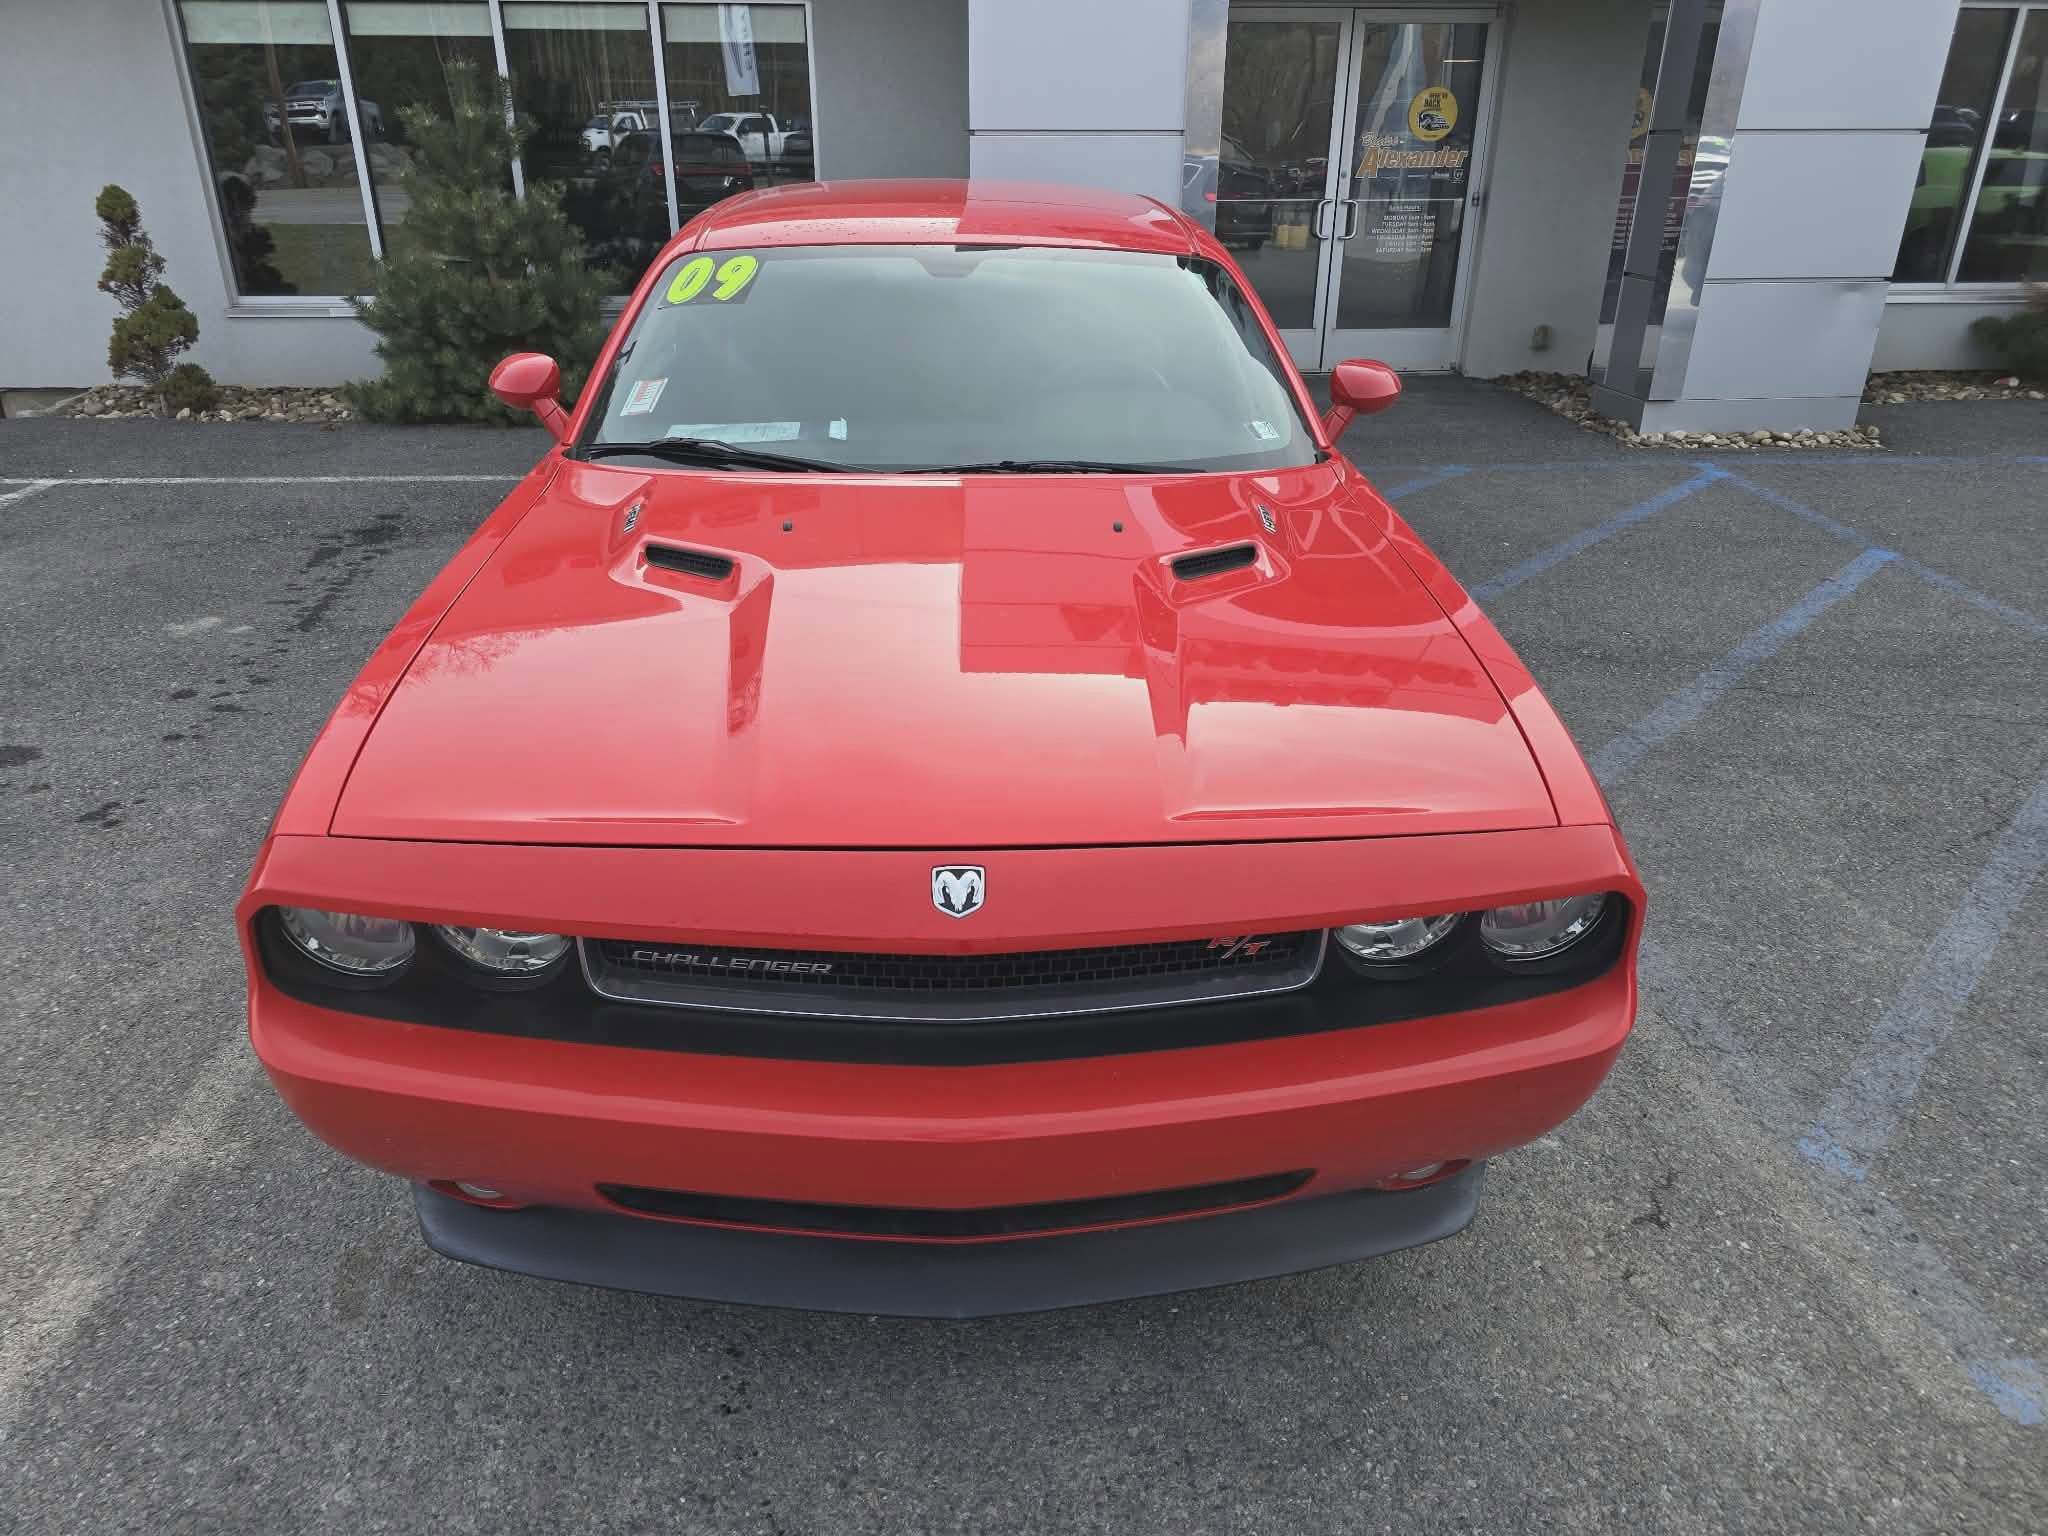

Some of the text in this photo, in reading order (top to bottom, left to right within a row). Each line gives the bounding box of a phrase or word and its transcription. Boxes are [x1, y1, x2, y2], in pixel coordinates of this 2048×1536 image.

[1354, 145, 1469, 179] Alexander
[666, 256, 759, 305] 09
[1207, 935, 1272, 959] R/T
[631, 950, 833, 975] CHALLENGER
